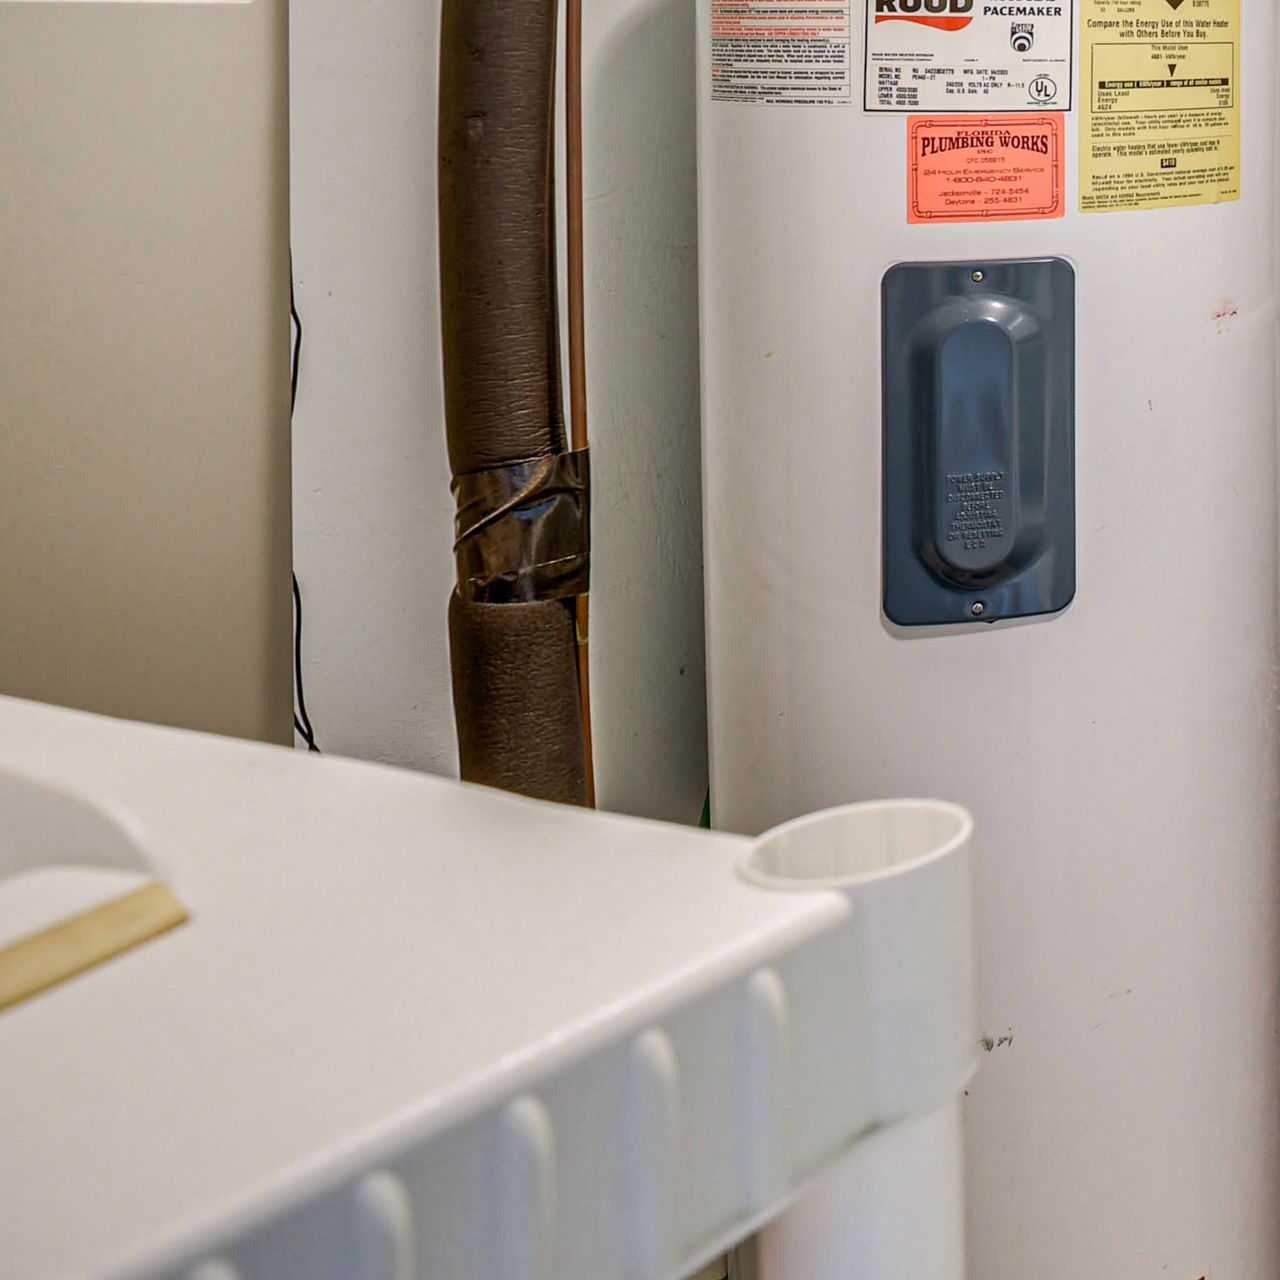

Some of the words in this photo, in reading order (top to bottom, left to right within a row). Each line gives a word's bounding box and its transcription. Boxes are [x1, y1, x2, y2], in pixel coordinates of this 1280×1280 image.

[983, 6, 1062, 16] PACEMAKER
[1087, 19, 1120, 29] Compare
[1122, 20, 1133, 28] the
[1136, 19, 1159, 29] Energy
[1119, 30, 1134, 38] with
[1137, 30, 1158, 38] Others
[1161, 30, 1180, 38] Before
[1183, 30, 1194, 38] You
[1195, 29, 1208, 39] Buy.
[921, 136, 994, 157] PLUMBING
[1000, 135, 1048, 155] WORKS
[939, 188, 982, 197] Jacksonville
